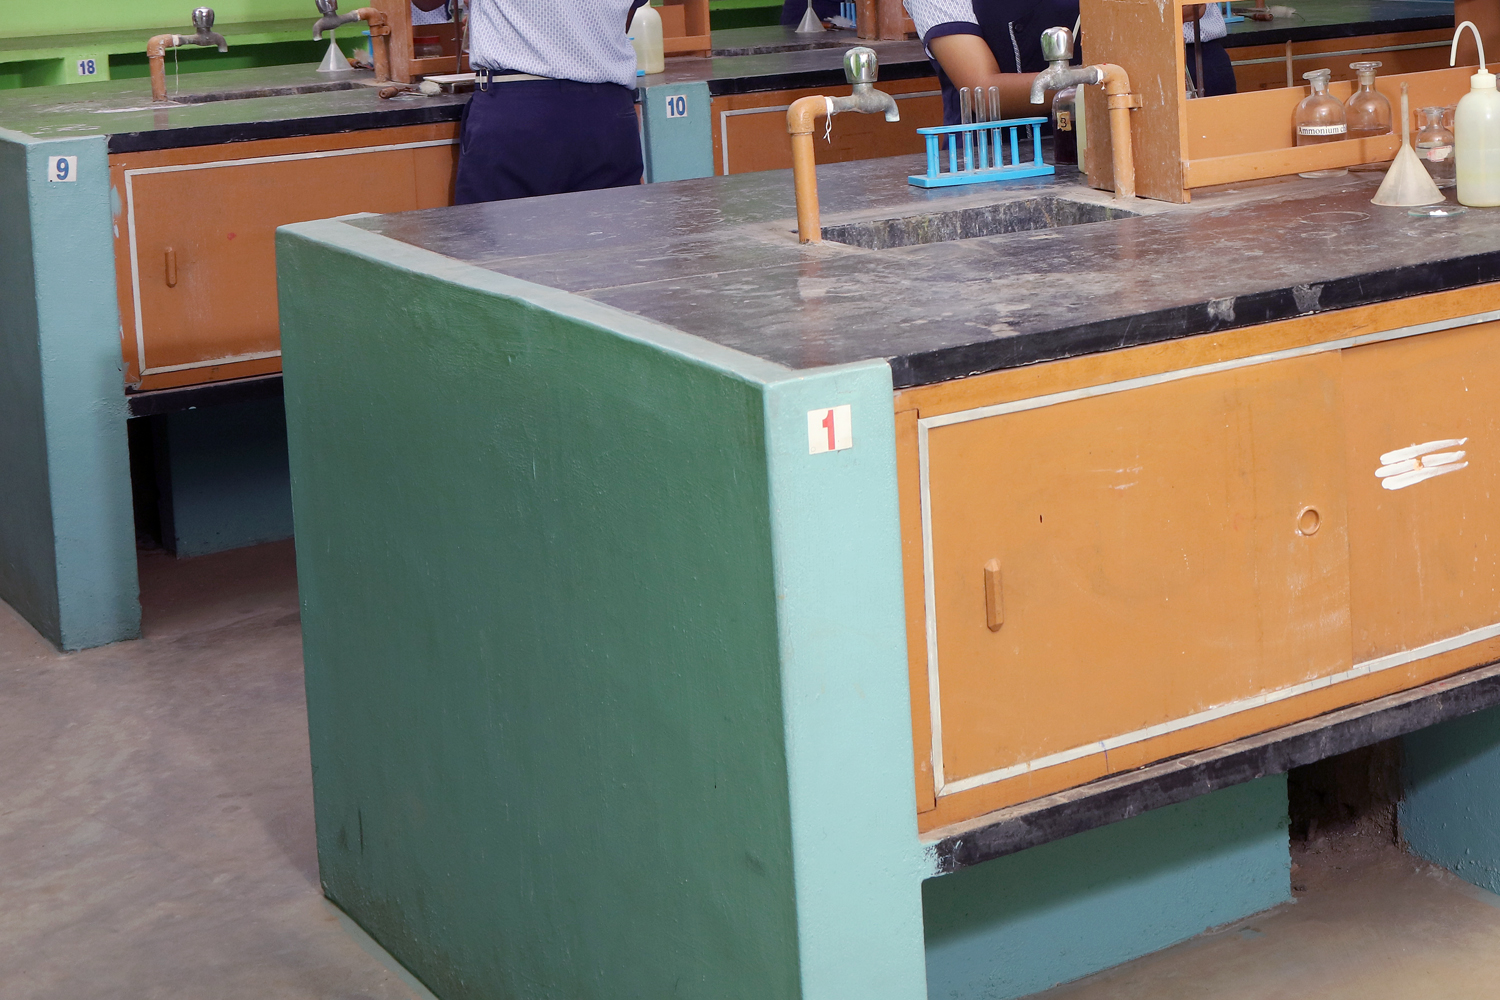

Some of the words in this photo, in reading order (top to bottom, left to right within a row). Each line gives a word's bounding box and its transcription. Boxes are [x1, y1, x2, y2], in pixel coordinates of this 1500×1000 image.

[79, 59, 96, 75] 18
[667, 96, 686, 117] 10
[1299, 125, 1340, 135] Ammonium
[56, 157, 70, 181] 9
[821, 409, 836, 451] 1
